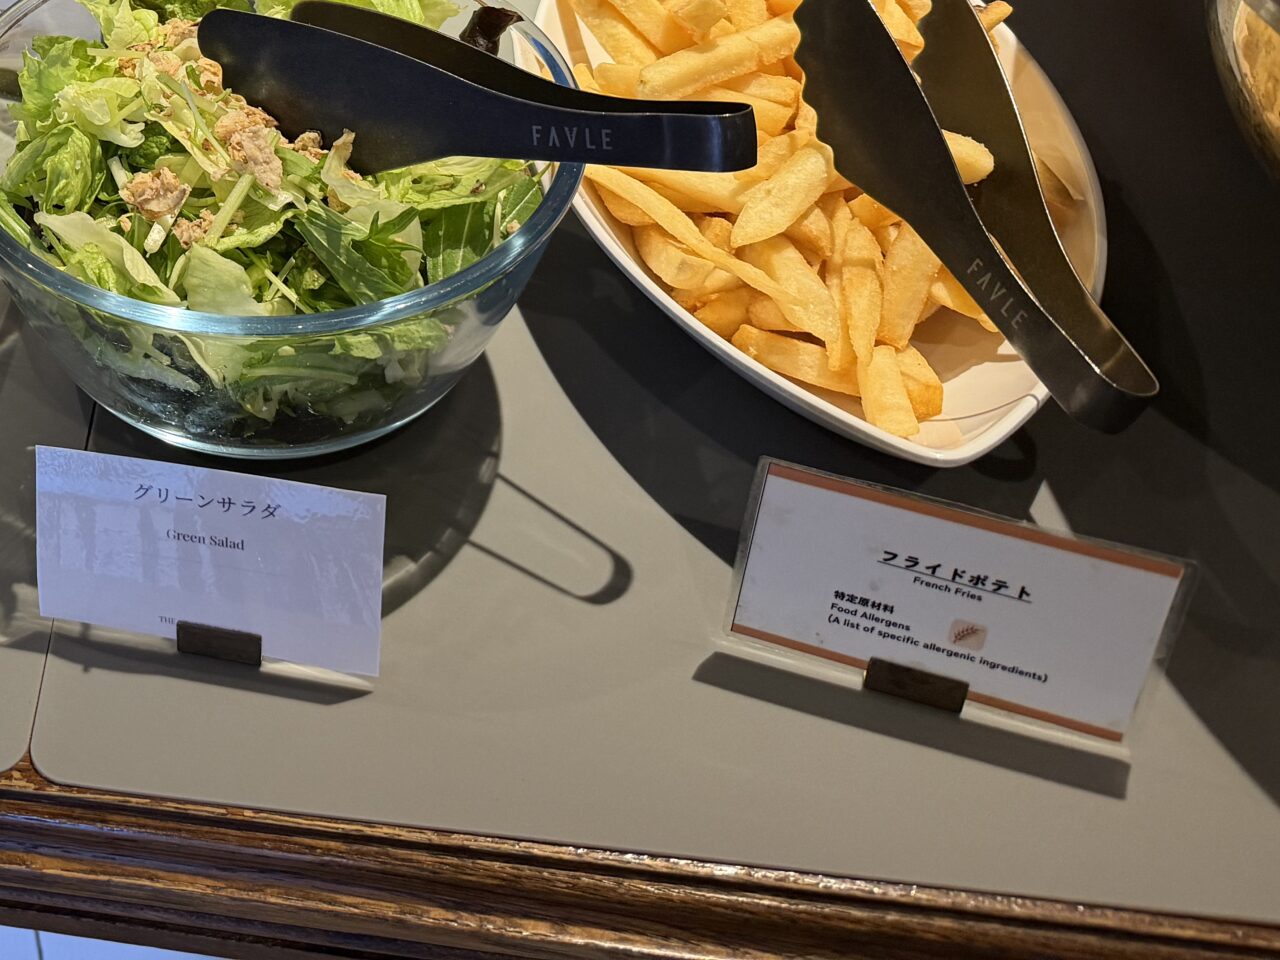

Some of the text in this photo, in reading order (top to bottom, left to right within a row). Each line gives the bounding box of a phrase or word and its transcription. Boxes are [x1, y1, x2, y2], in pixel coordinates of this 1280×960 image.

[532, 125, 613, 150] FAVLE
[967, 257, 1028, 329] FAVLE
[134, 483, 281, 520] グリーンサラダ
[166, 527, 245, 551] Green Salad
[882, 550, 1031, 600] フライドポテト
[913, 575, 983, 602] French Fries
[833, 590, 894, 615] 特定原材料
[158, 614, 176, 626] THE
[830, 602, 911, 632] Food Allergens
[827, 613, 1048, 683] (A list of specific allergenic ingredients)
